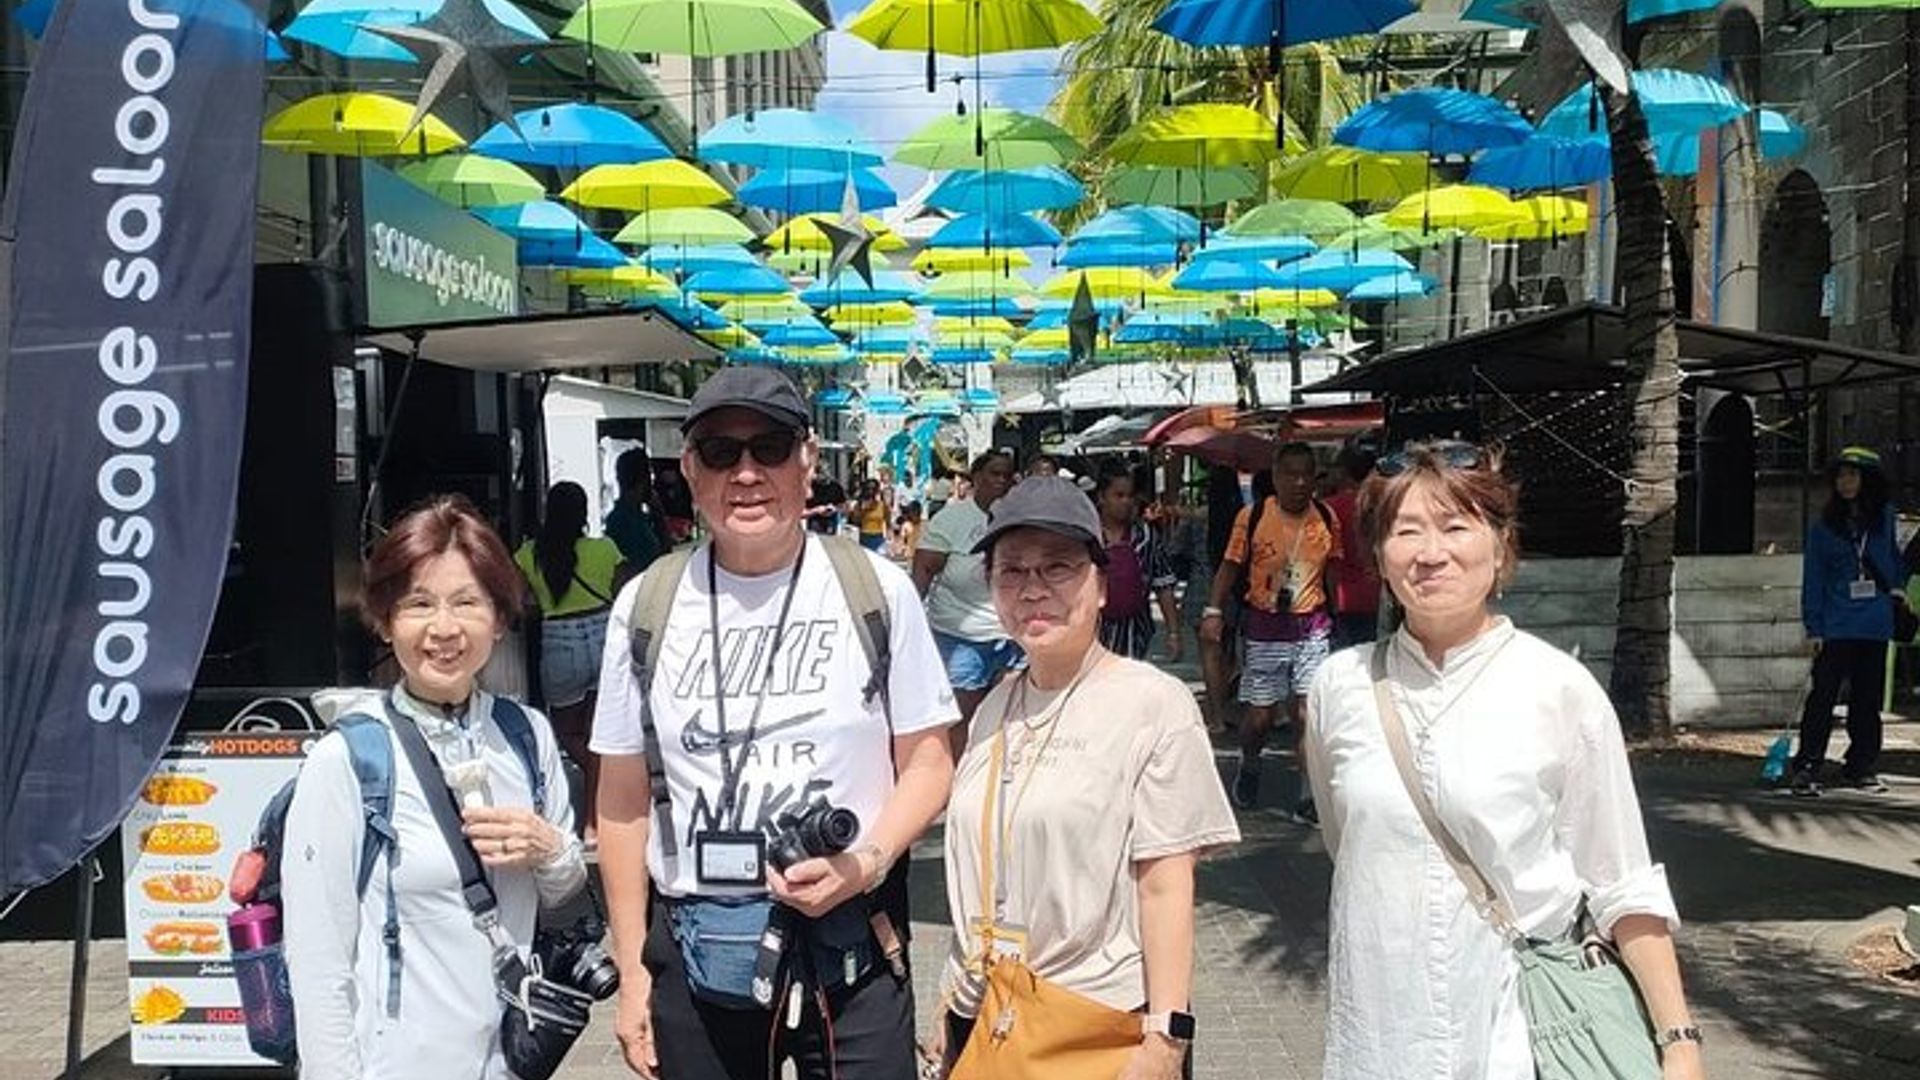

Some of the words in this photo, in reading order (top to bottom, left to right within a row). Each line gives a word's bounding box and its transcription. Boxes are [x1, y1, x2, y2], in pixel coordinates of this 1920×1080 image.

[371, 221, 460, 306] sausage
[461, 254, 514, 314] saloon
[87, 326, 181, 725] sausage
[675, 620, 838, 699] NIKE
[210, 739, 298, 754] HOTDOGS
[743, 740, 818, 768] AIR
[207, 1009, 246, 1022] KIDS
